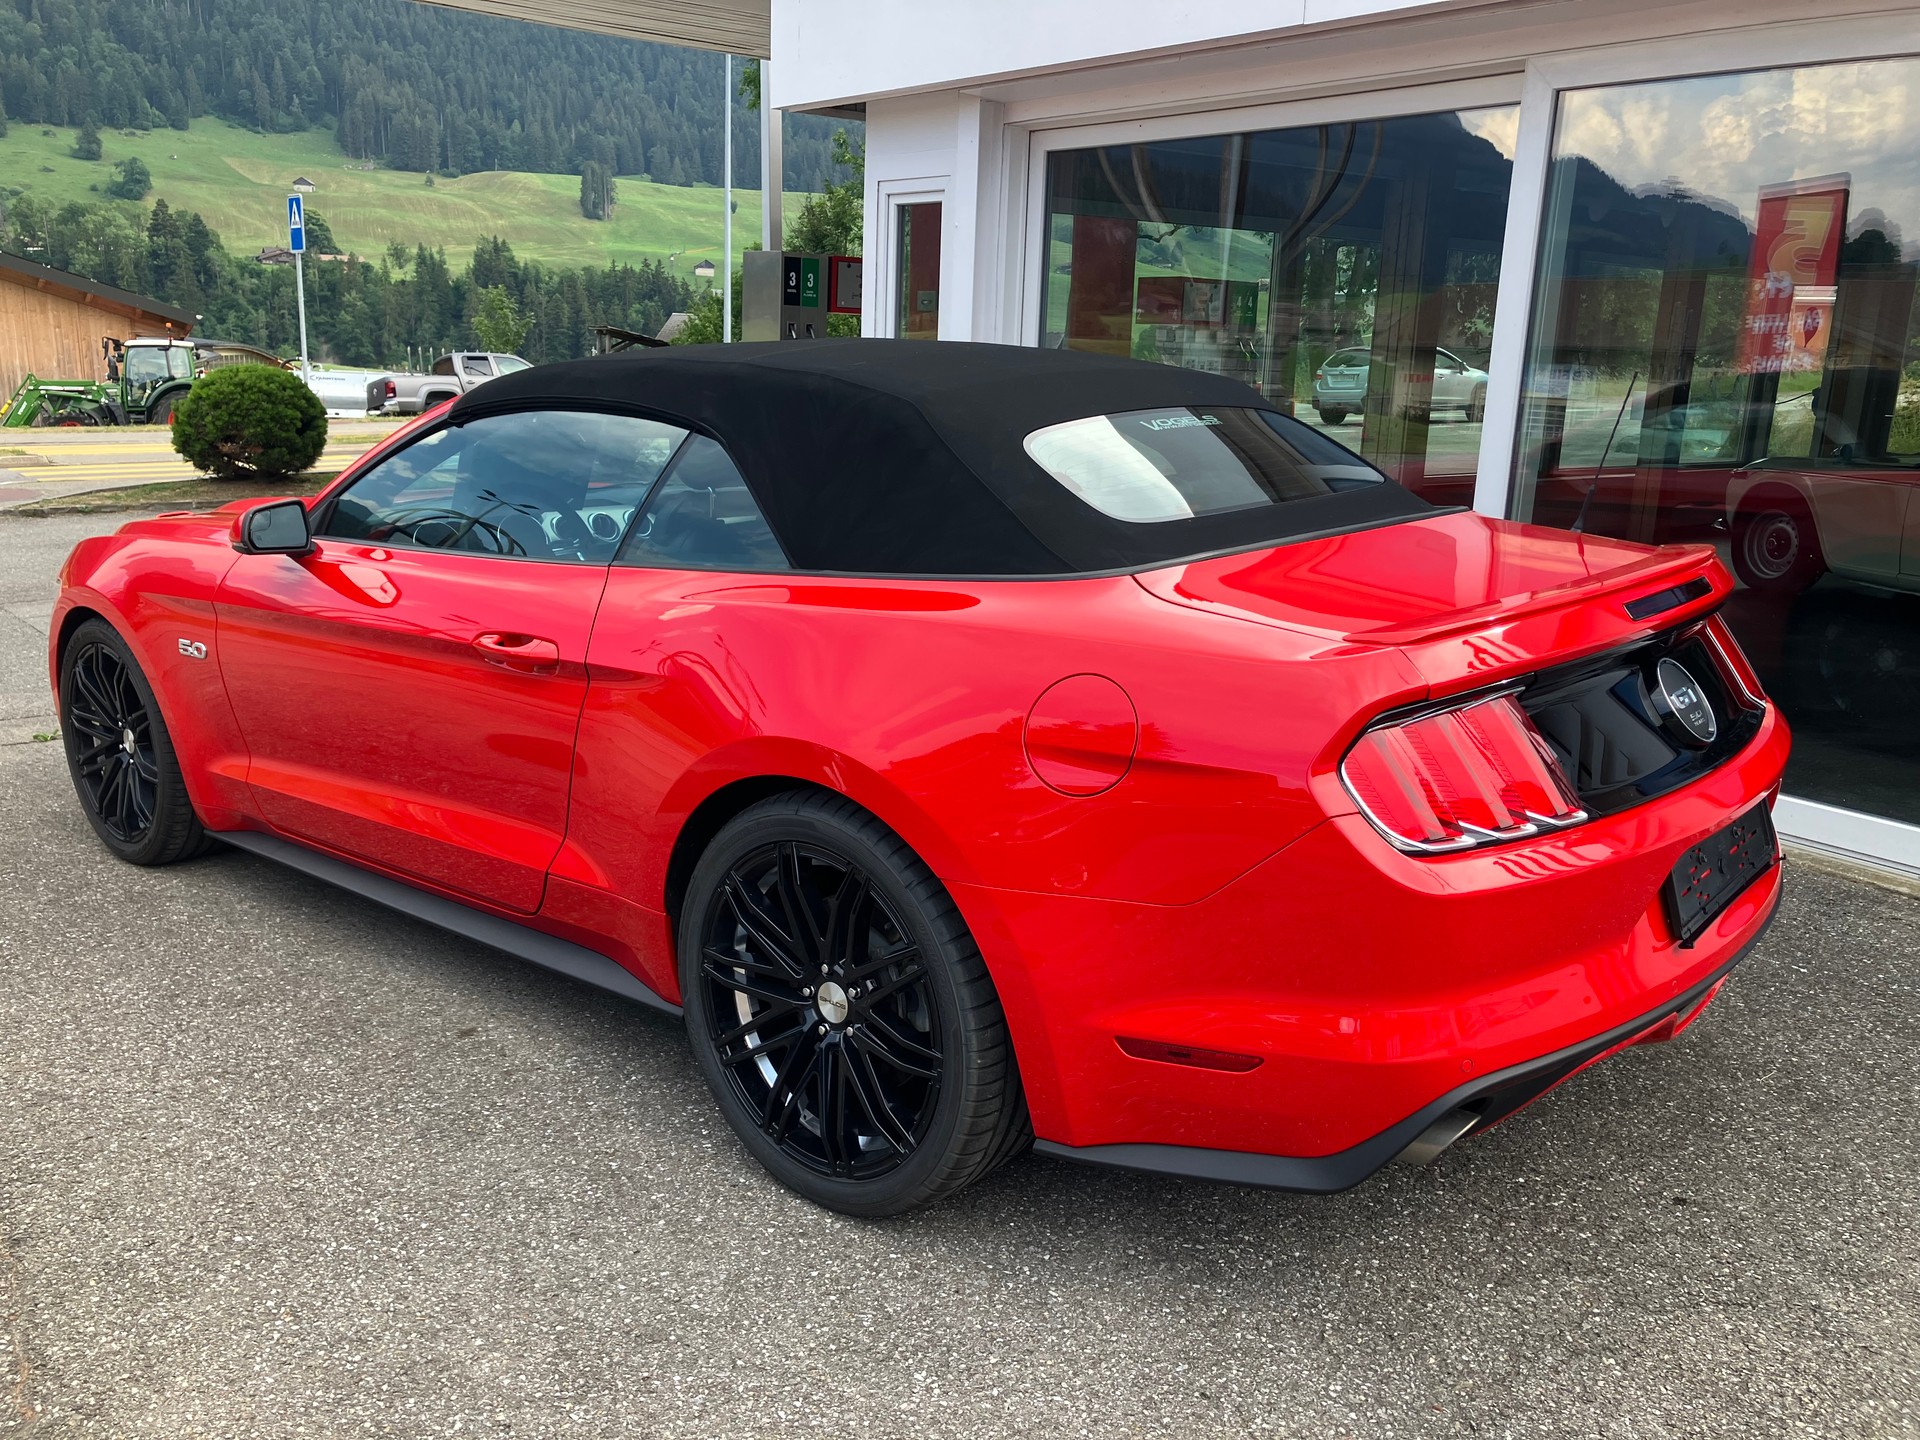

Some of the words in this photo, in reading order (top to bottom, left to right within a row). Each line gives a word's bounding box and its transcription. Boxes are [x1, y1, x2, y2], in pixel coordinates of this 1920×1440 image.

[789, 272, 796, 287] 3
[807, 273, 814, 288] 3
[1139, 415, 1218, 431] VOGELS
